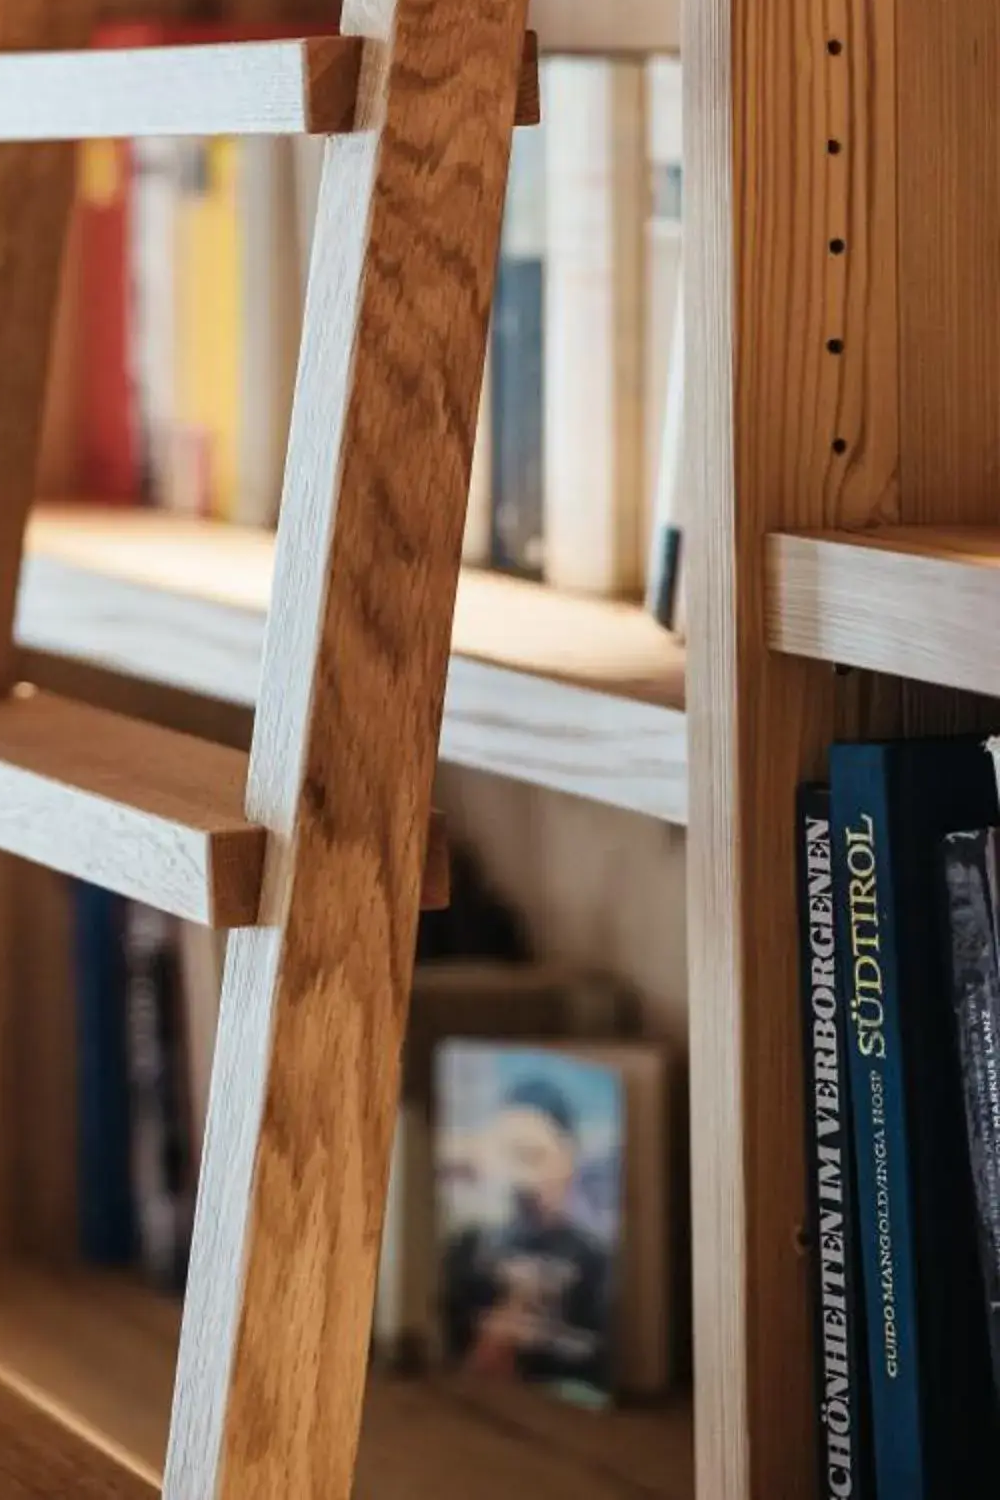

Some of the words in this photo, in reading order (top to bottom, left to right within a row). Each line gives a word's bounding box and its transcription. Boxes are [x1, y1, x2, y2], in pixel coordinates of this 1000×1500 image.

[846, 813, 886, 1060] SÜDTIROL
[806, 815, 840, 1137] VERBORGENEN
[981, 1009, 994, 1054] LANZ
[987, 1059, 1000, 1129] MARKUS
[817, 1147, 843, 1201] IM
[872, 1128, 895, 1301] MANGOLD/INGA
[883, 1305, 898, 1378] GUIDO
